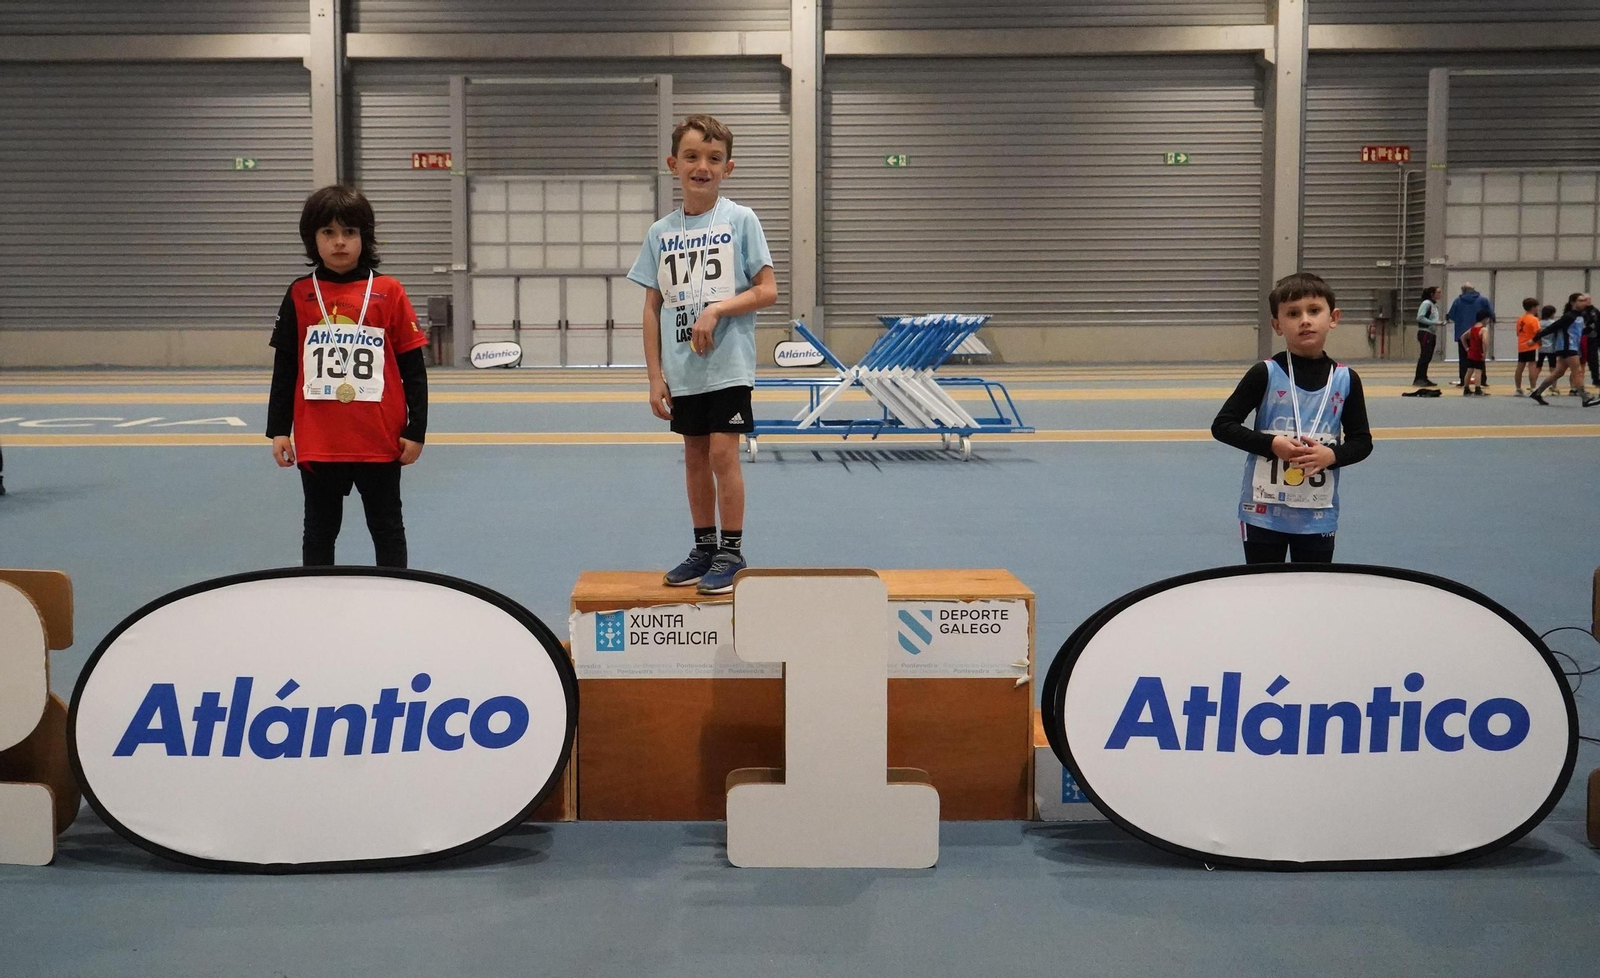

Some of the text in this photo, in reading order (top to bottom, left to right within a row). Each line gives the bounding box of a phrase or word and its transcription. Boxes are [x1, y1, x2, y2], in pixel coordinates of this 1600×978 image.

[660, 232, 732, 252] Atlántico
[664, 248, 722, 286] 175
[676, 312, 688, 327] CO
[307, 328, 384, 347] Atlántico
[474, 349, 519, 361] Atlántico
[312, 347, 374, 380] 138
[0, 416, 248, 428] CIA
[630, 614, 684, 628] XUNTA
[939, 609, 1009, 621] DEPORTE
[939, 623, 1002, 634] GALEGO
[630, 631, 718, 645] DE GALICIA
[111, 672, 531, 760] Atlántico
[1104, 671, 1531, 757] Atlántico
